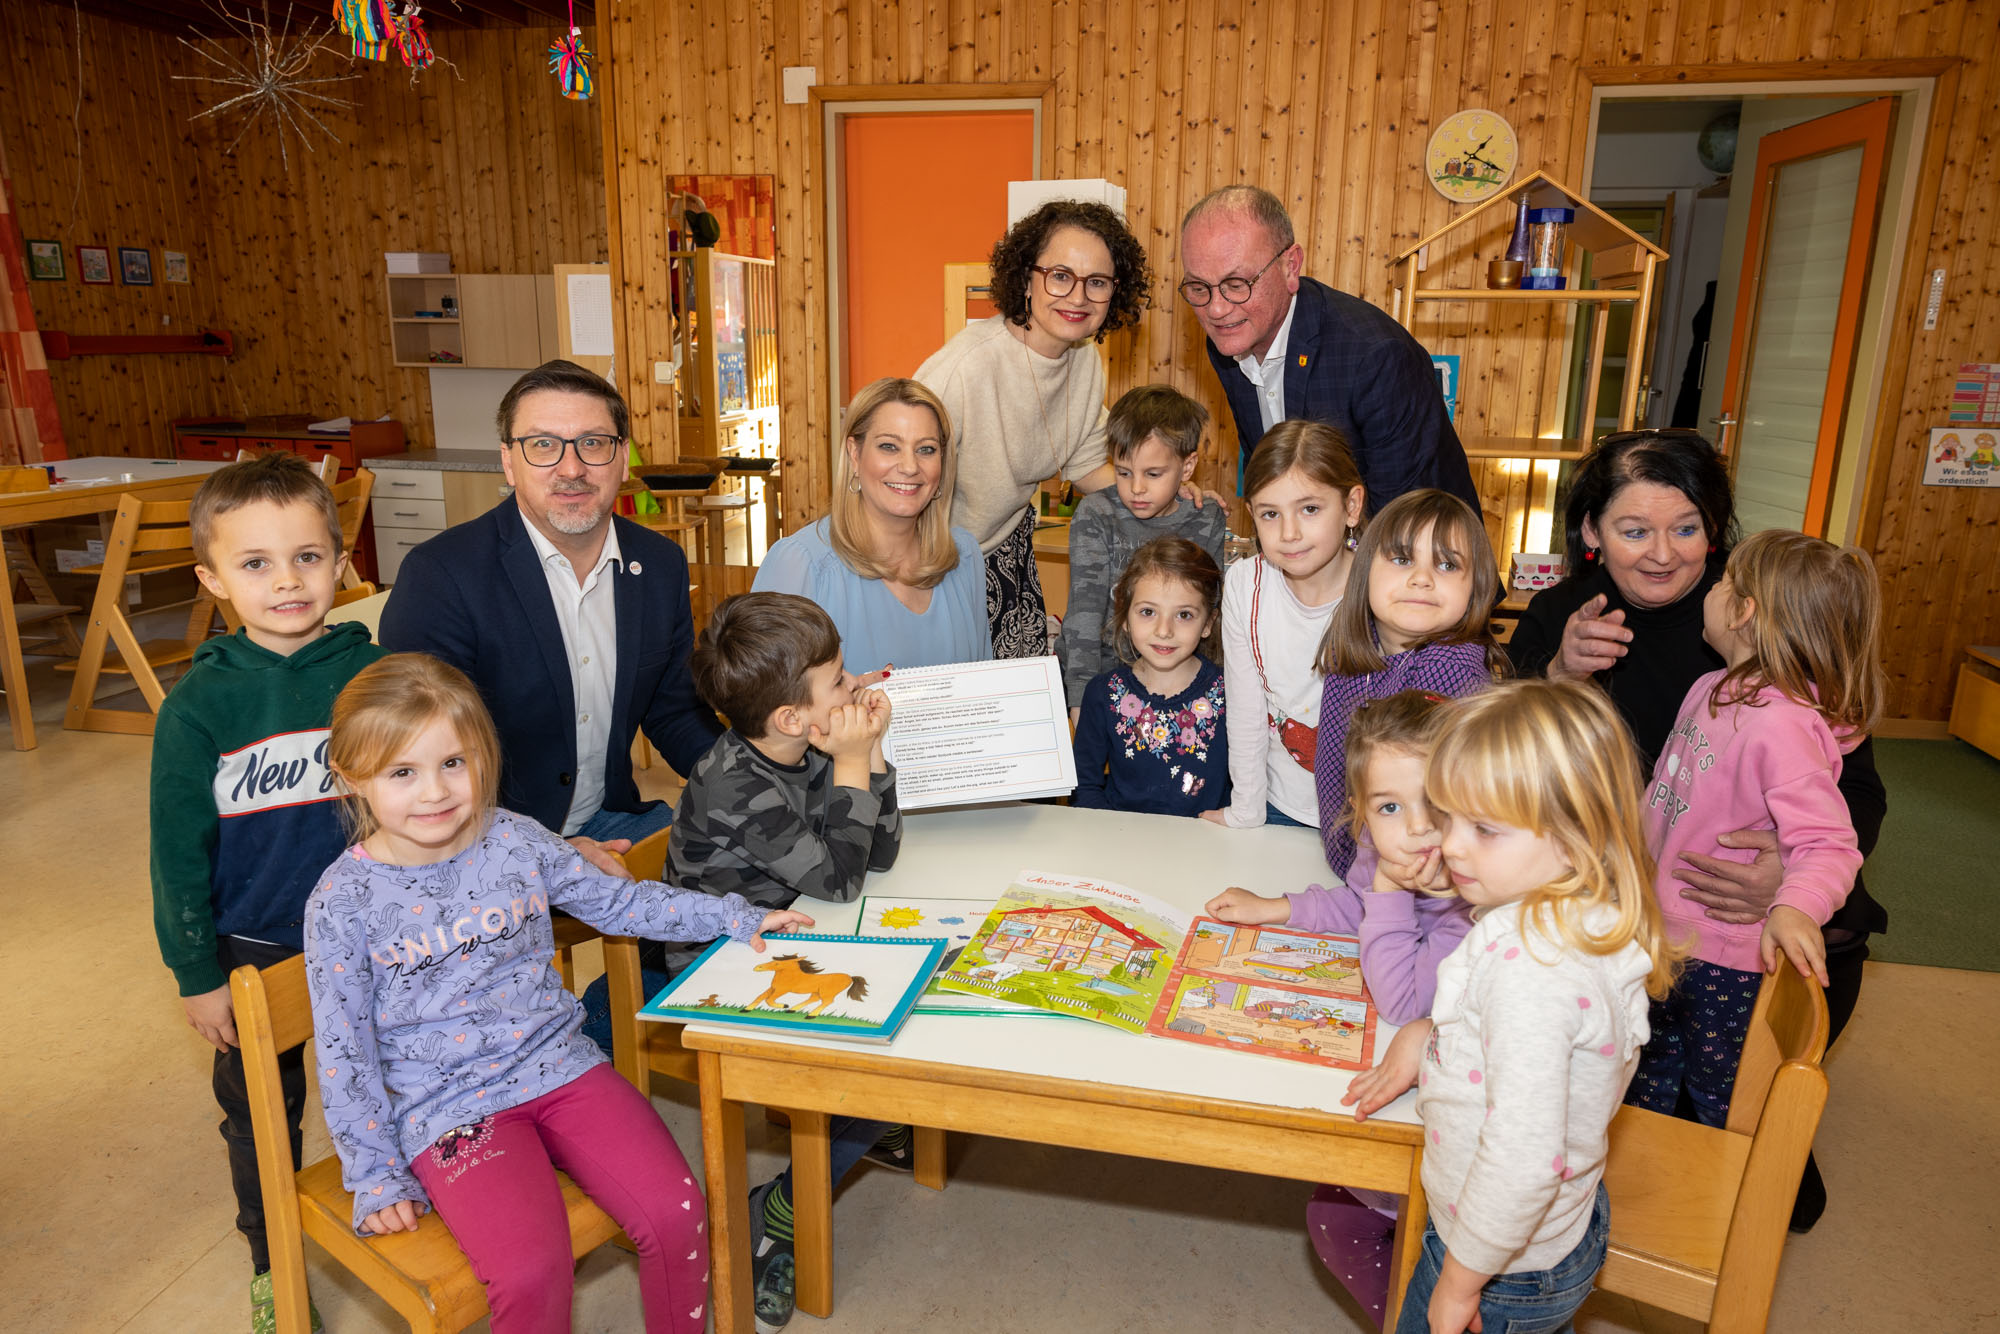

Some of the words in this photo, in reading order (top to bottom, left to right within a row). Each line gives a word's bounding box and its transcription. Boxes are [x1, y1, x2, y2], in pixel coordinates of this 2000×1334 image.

[1938, 477, 1989, 485] ordentlich!
[231, 747, 309, 802] New
[1649, 780, 1690, 828] PPY
[1073, 881, 1141, 904] Zuhause
[370, 892, 549, 966] UNICORN
[445, 1162, 468, 1187] Wild
